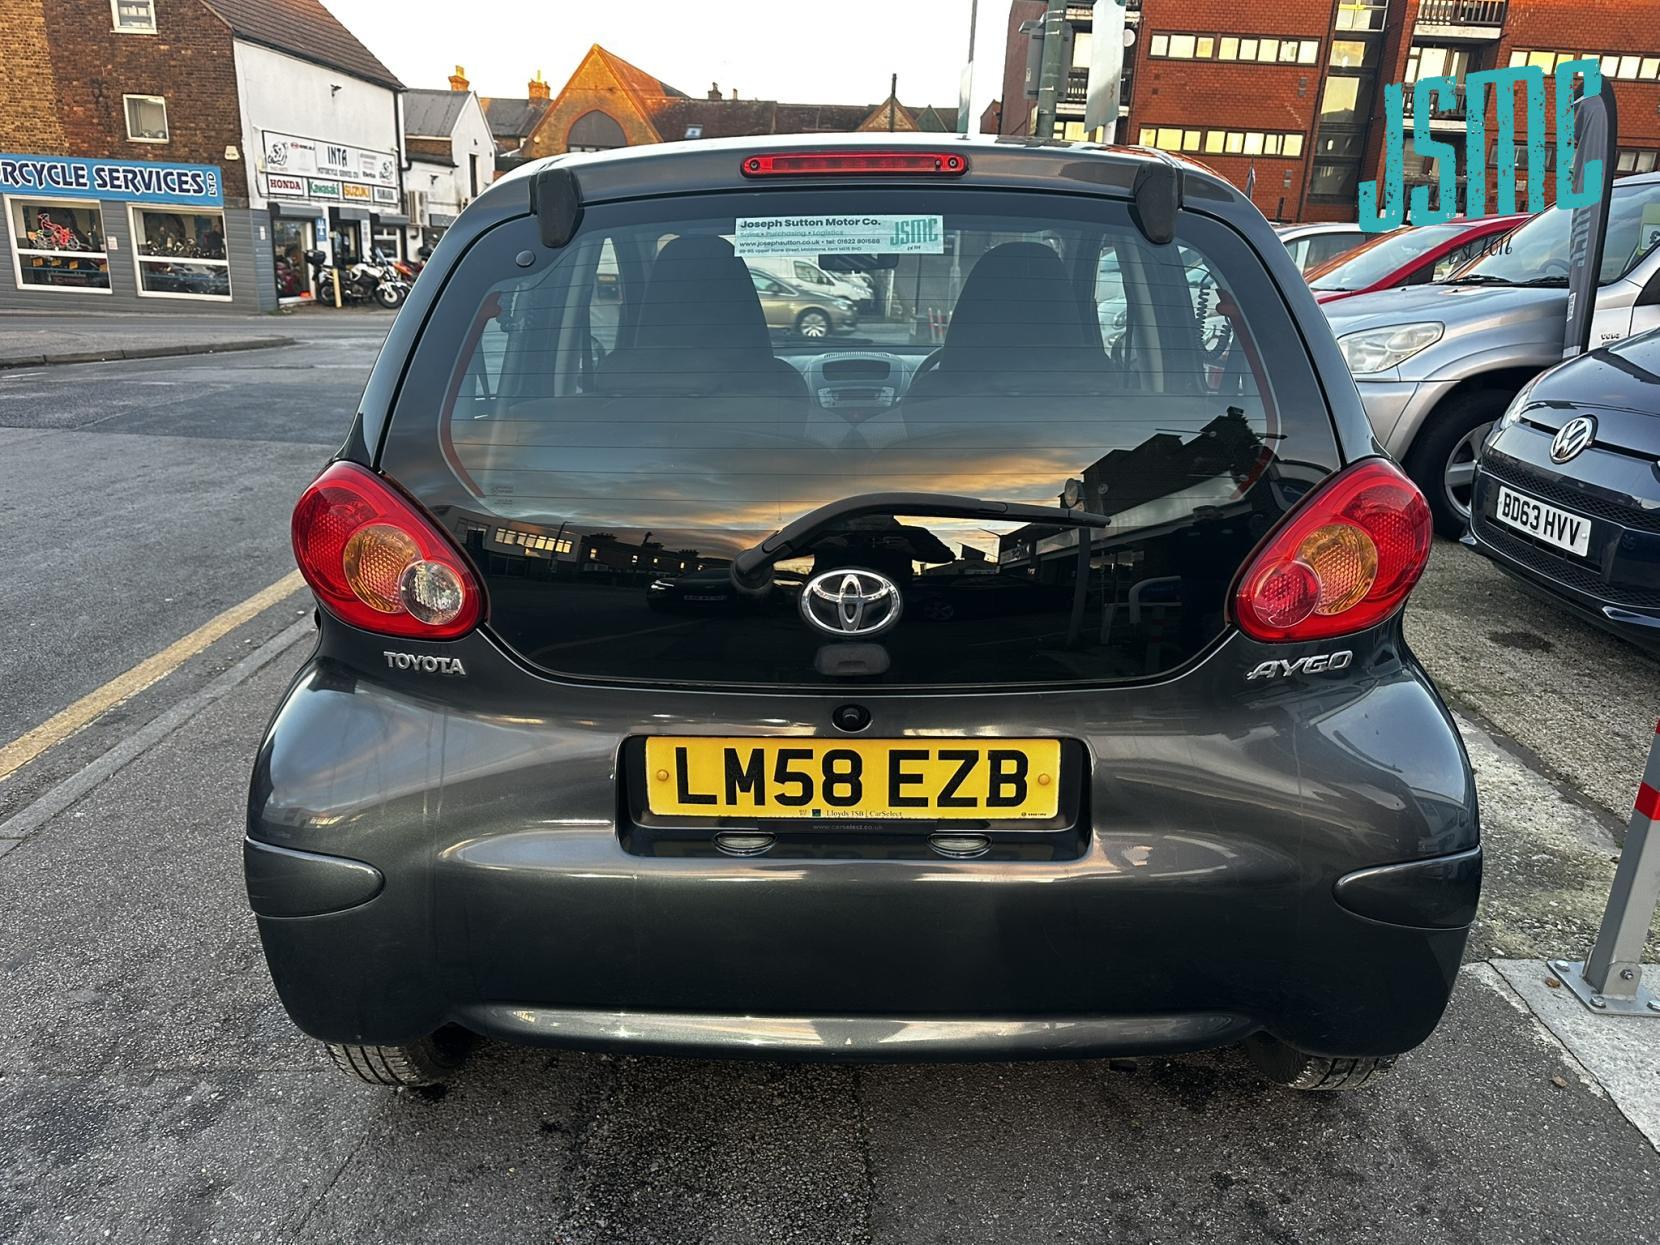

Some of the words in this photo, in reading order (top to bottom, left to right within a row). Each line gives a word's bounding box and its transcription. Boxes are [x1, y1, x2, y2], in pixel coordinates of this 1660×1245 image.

[327, 146, 348, 167] INTA
[94, 165, 206, 196] SERVICES
[207, 172, 217, 196] LTD
[270, 179, 301, 190] HONDA
[310, 181, 340, 195] Kawasaki
[344, 184, 370, 197] SUZUKI
[740, 219, 782, 230] Joseph
[784, 218, 823, 227] Sutton
[825, 218, 860, 226] Motor
[862, 217, 881, 226] Co.
[889, 218, 939, 246] JSMC
[740, 239, 820, 247] www.josephsutton.co.uk
[1502, 492, 1541, 530] BD63
[1543, 509, 1581, 546] HVV
[383, 651, 466, 675] TOYOTA
[1246, 650, 1353, 680] AYGO
[675, 747, 863, 807] LM58
[888, 749, 1029, 807] EZB
[826, 808, 849, 818] Lloyds
[851, 809, 864, 817] TSB
[869, 809, 902, 817] CarSelect
